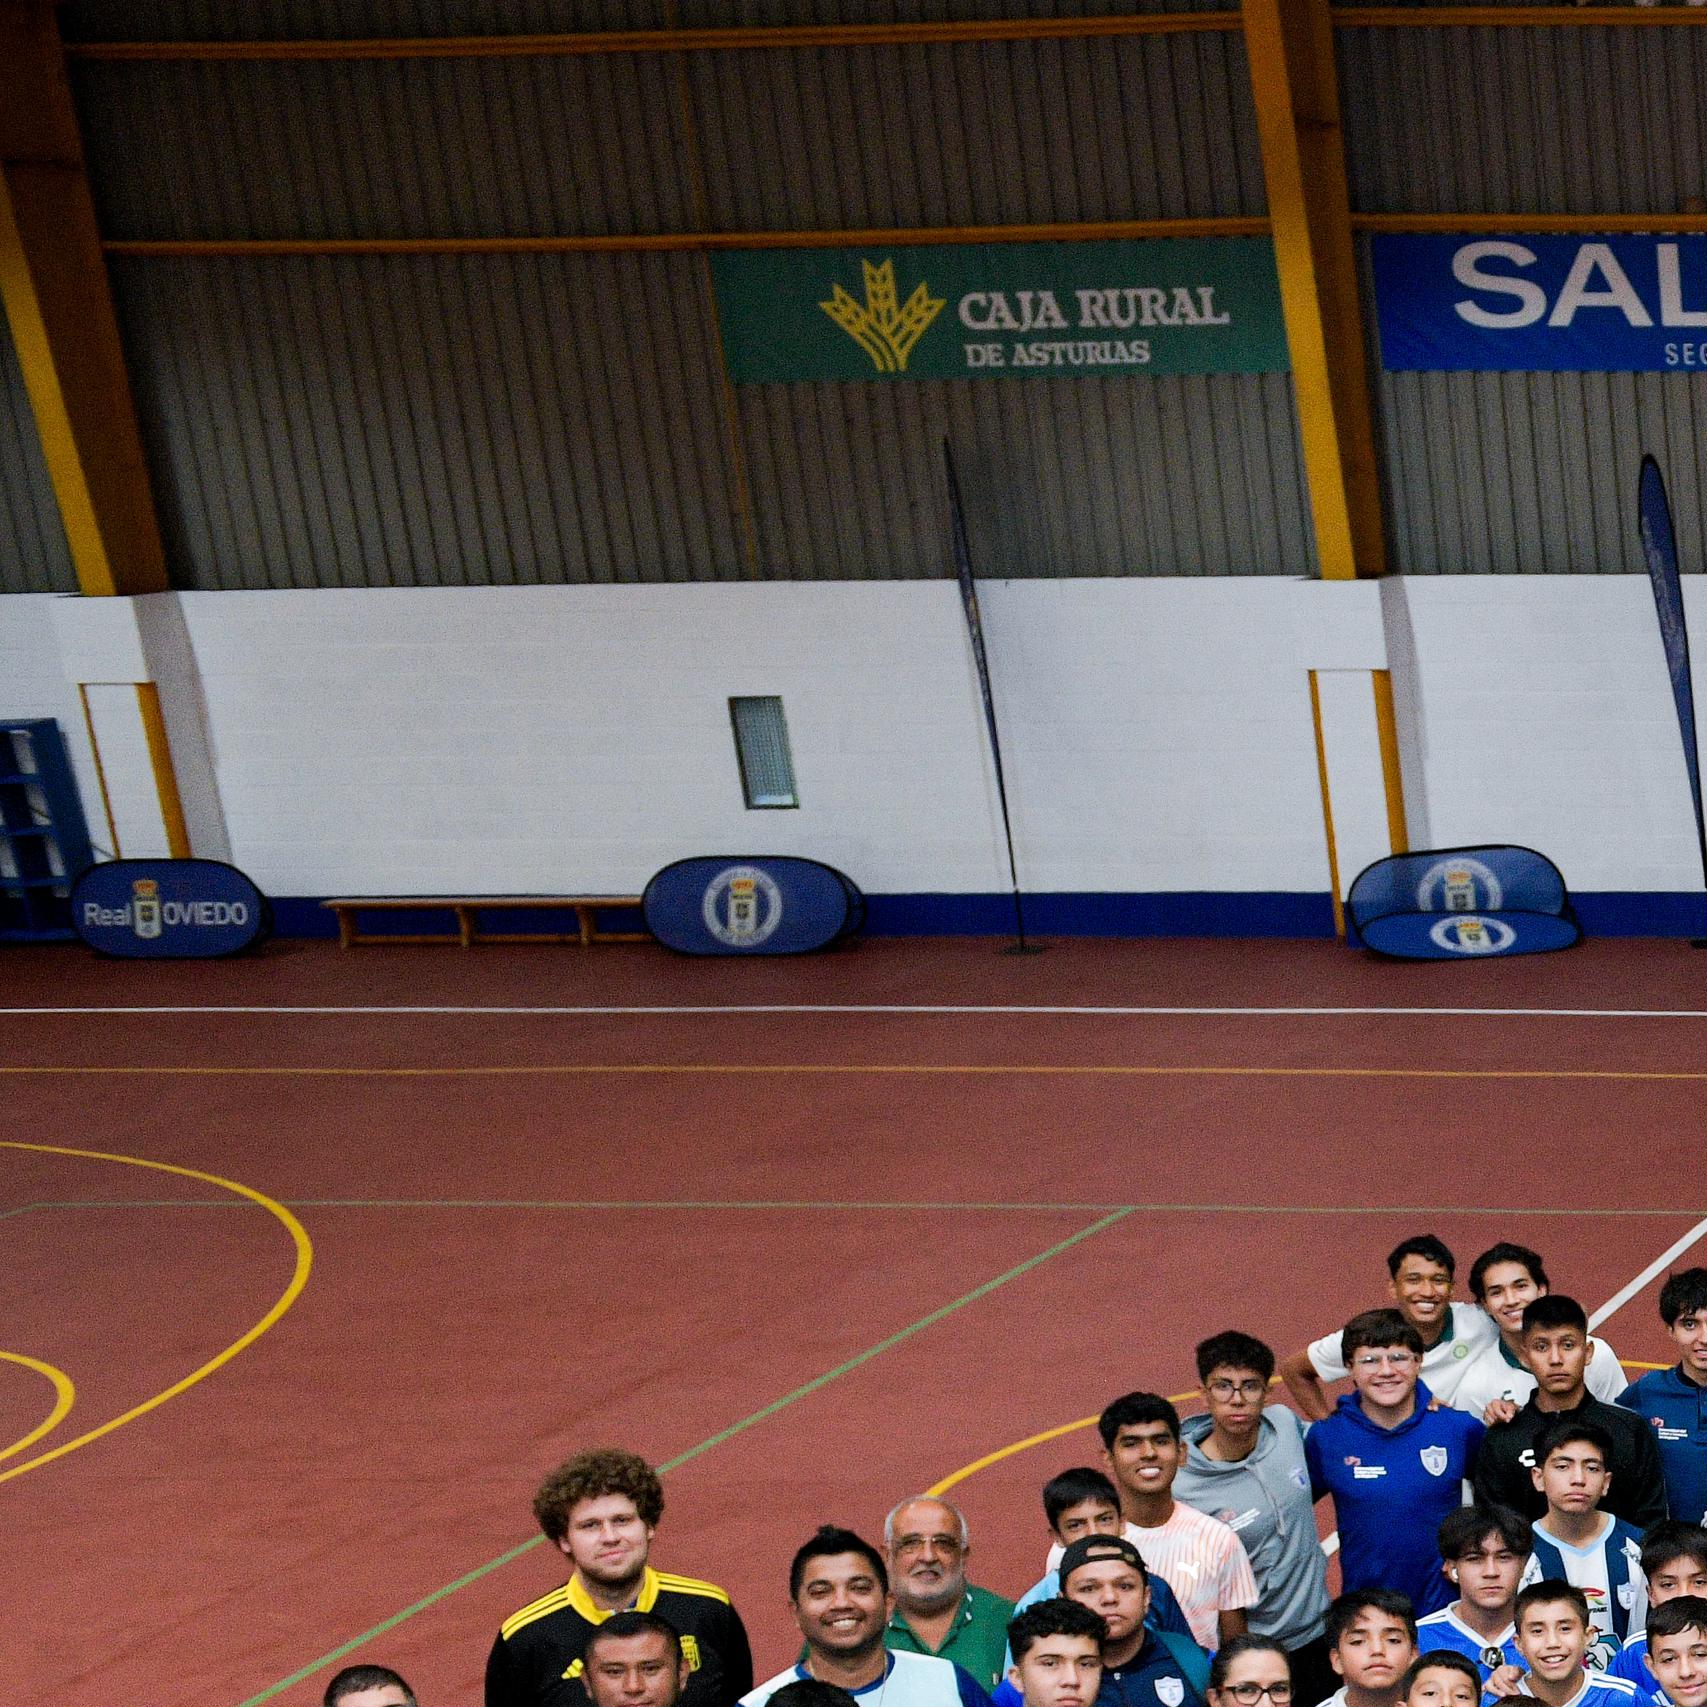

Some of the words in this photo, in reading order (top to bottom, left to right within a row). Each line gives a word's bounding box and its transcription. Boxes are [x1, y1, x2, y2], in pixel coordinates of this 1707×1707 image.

[958, 289, 1068, 333] CAJA
[1075, 286, 1230, 328] RURAL
[966, 343, 1005, 367] DE
[1013, 339, 1151, 365] ASTURIAS
[83, 902, 131, 927] Real
[163, 901, 249, 926] OVIEDO
